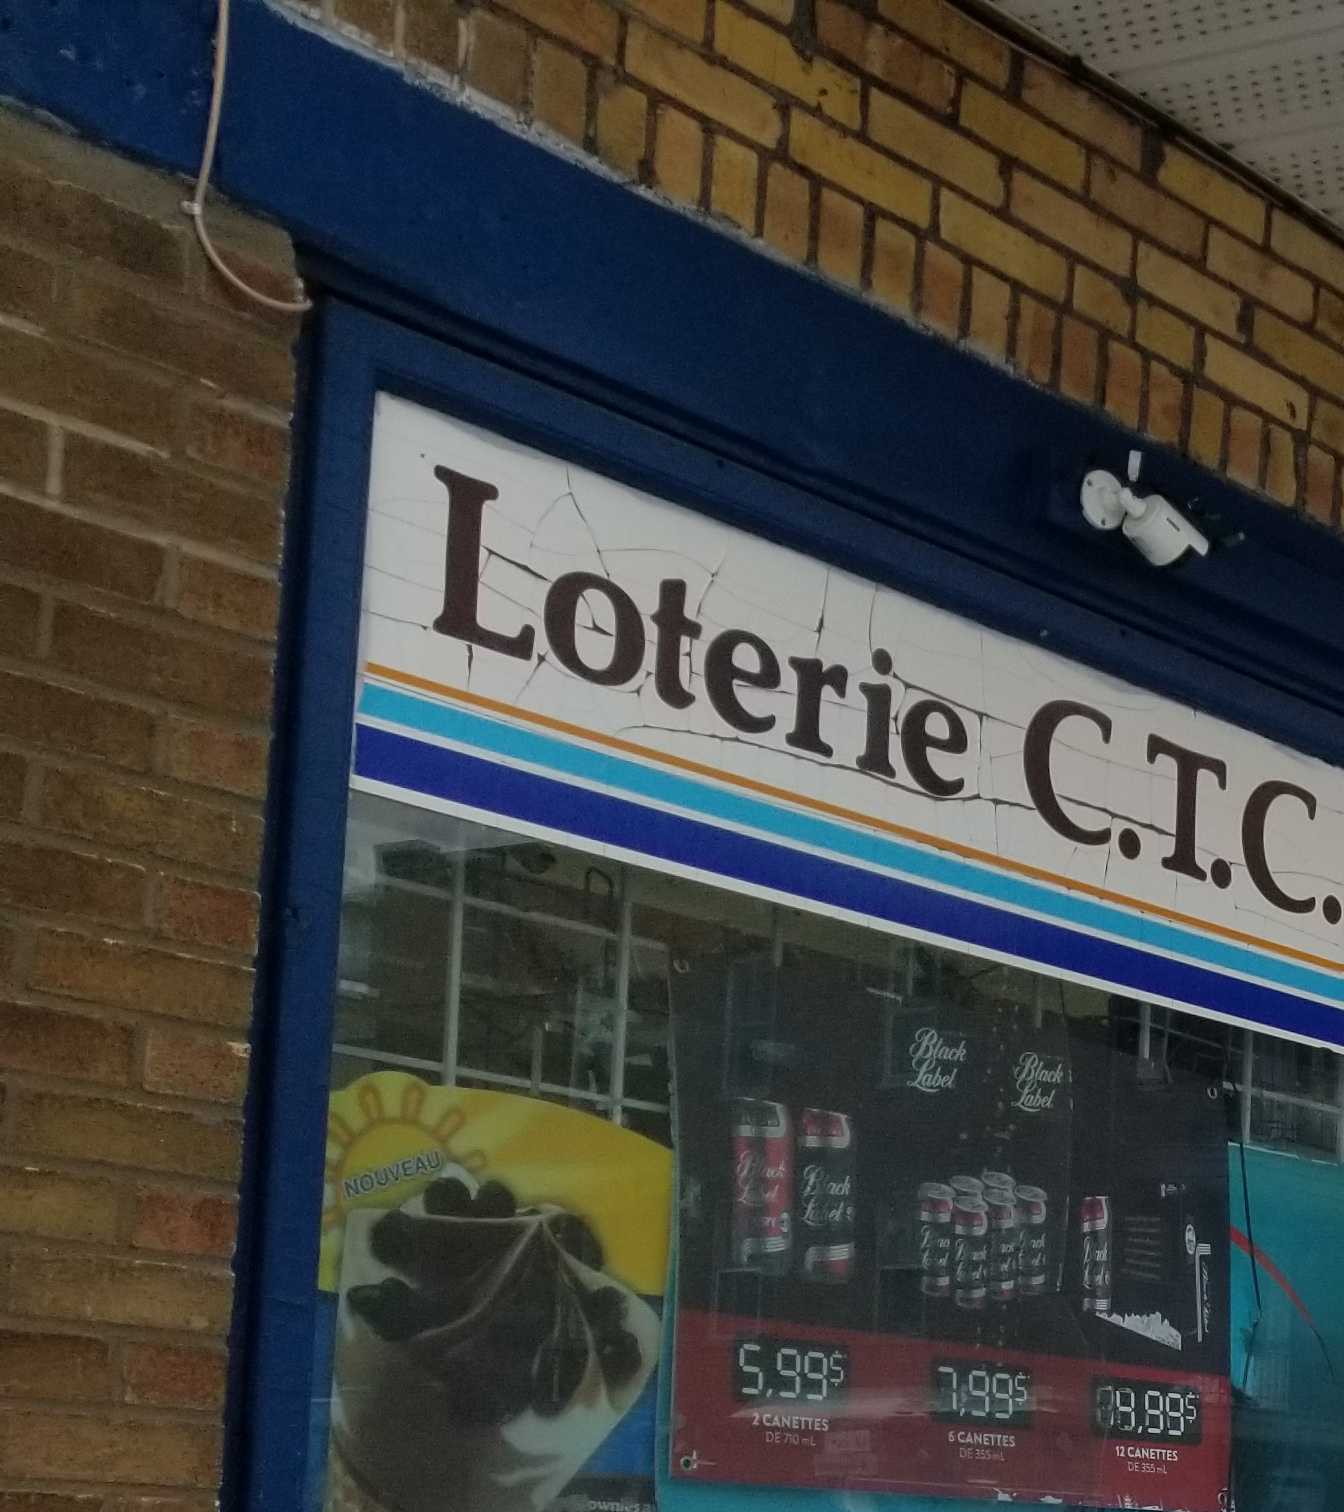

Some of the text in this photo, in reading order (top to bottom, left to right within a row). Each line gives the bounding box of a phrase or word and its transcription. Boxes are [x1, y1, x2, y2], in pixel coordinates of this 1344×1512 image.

[433, 465, 968, 797] Loterie
[909, 1027, 967, 1061] Black
[906, 1058, 958, 1092] Label
[1012, 1052, 1064, 1083] Black
[1011, 1079, 1056, 1112] Label
[344, 1151, 441, 1199] NOUVEAU
[752, 1414, 829, 1432] 2 CANETTES
[765, 1431, 782, 1443] DE
[957, 1432, 1016, 1448] CANETTES
[959, 1447, 973, 1459] DE
[1115, 1445, 1178, 1462] 12 CANETTES
[1128, 1461, 1140, 1472] DE
